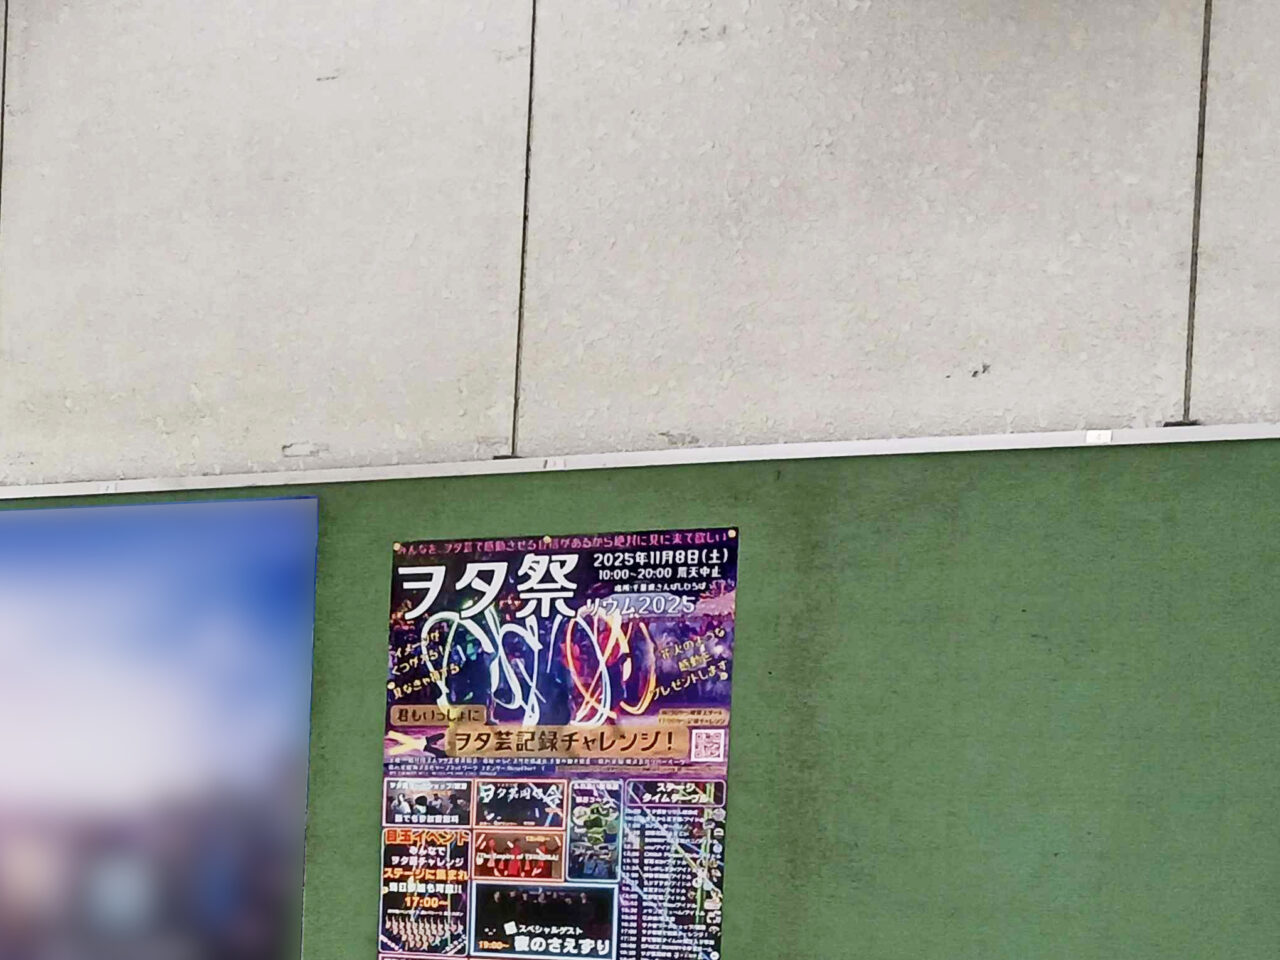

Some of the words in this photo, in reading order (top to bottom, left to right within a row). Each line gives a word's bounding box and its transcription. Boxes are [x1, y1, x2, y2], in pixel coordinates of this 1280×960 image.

[397, 552, 580, 620] ヲタ祭
[385, 829, 471, 846] 目玉イベント
